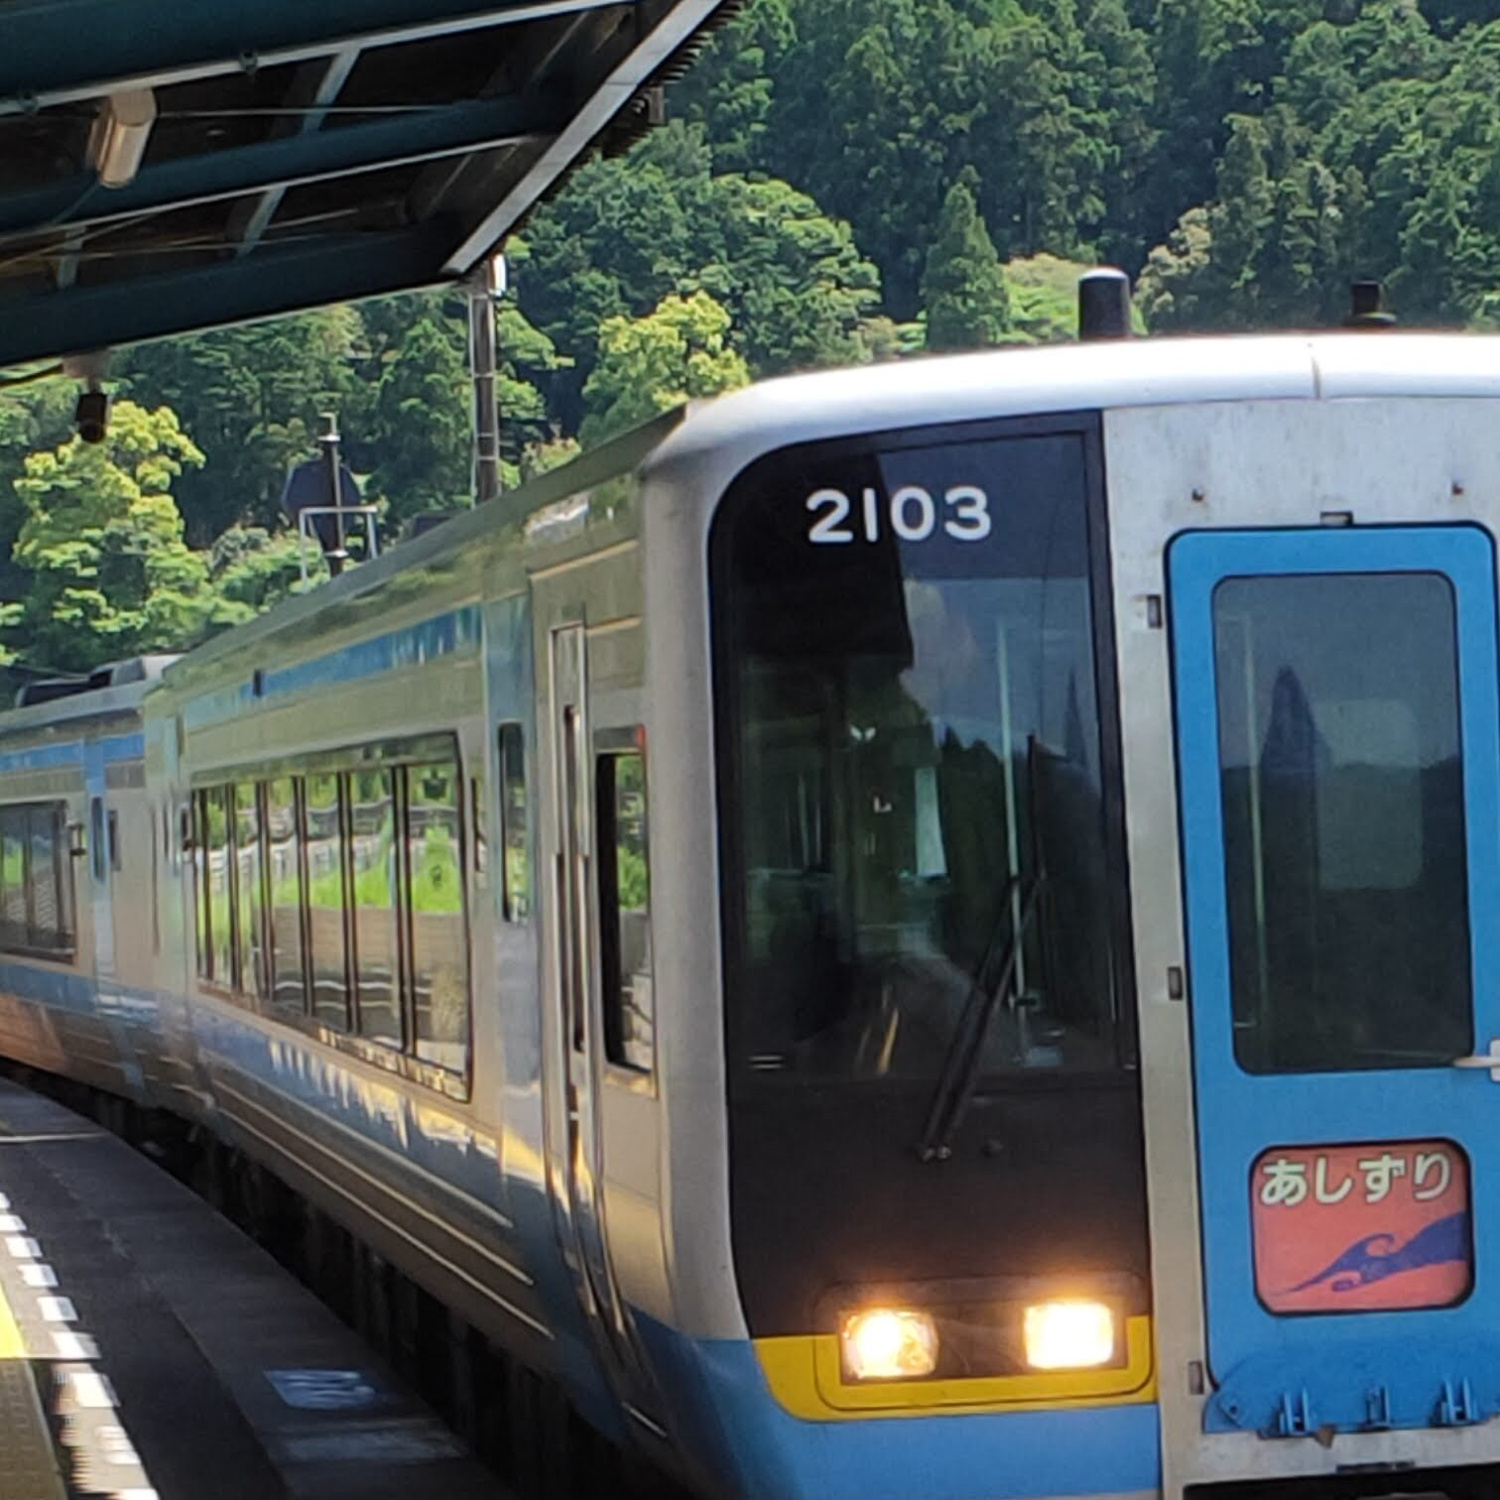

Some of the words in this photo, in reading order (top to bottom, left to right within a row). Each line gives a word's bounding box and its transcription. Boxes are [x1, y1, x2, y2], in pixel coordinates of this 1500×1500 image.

[806, 487, 991, 542] 2103
[1261, 1153, 1450, 1206] あしずり
